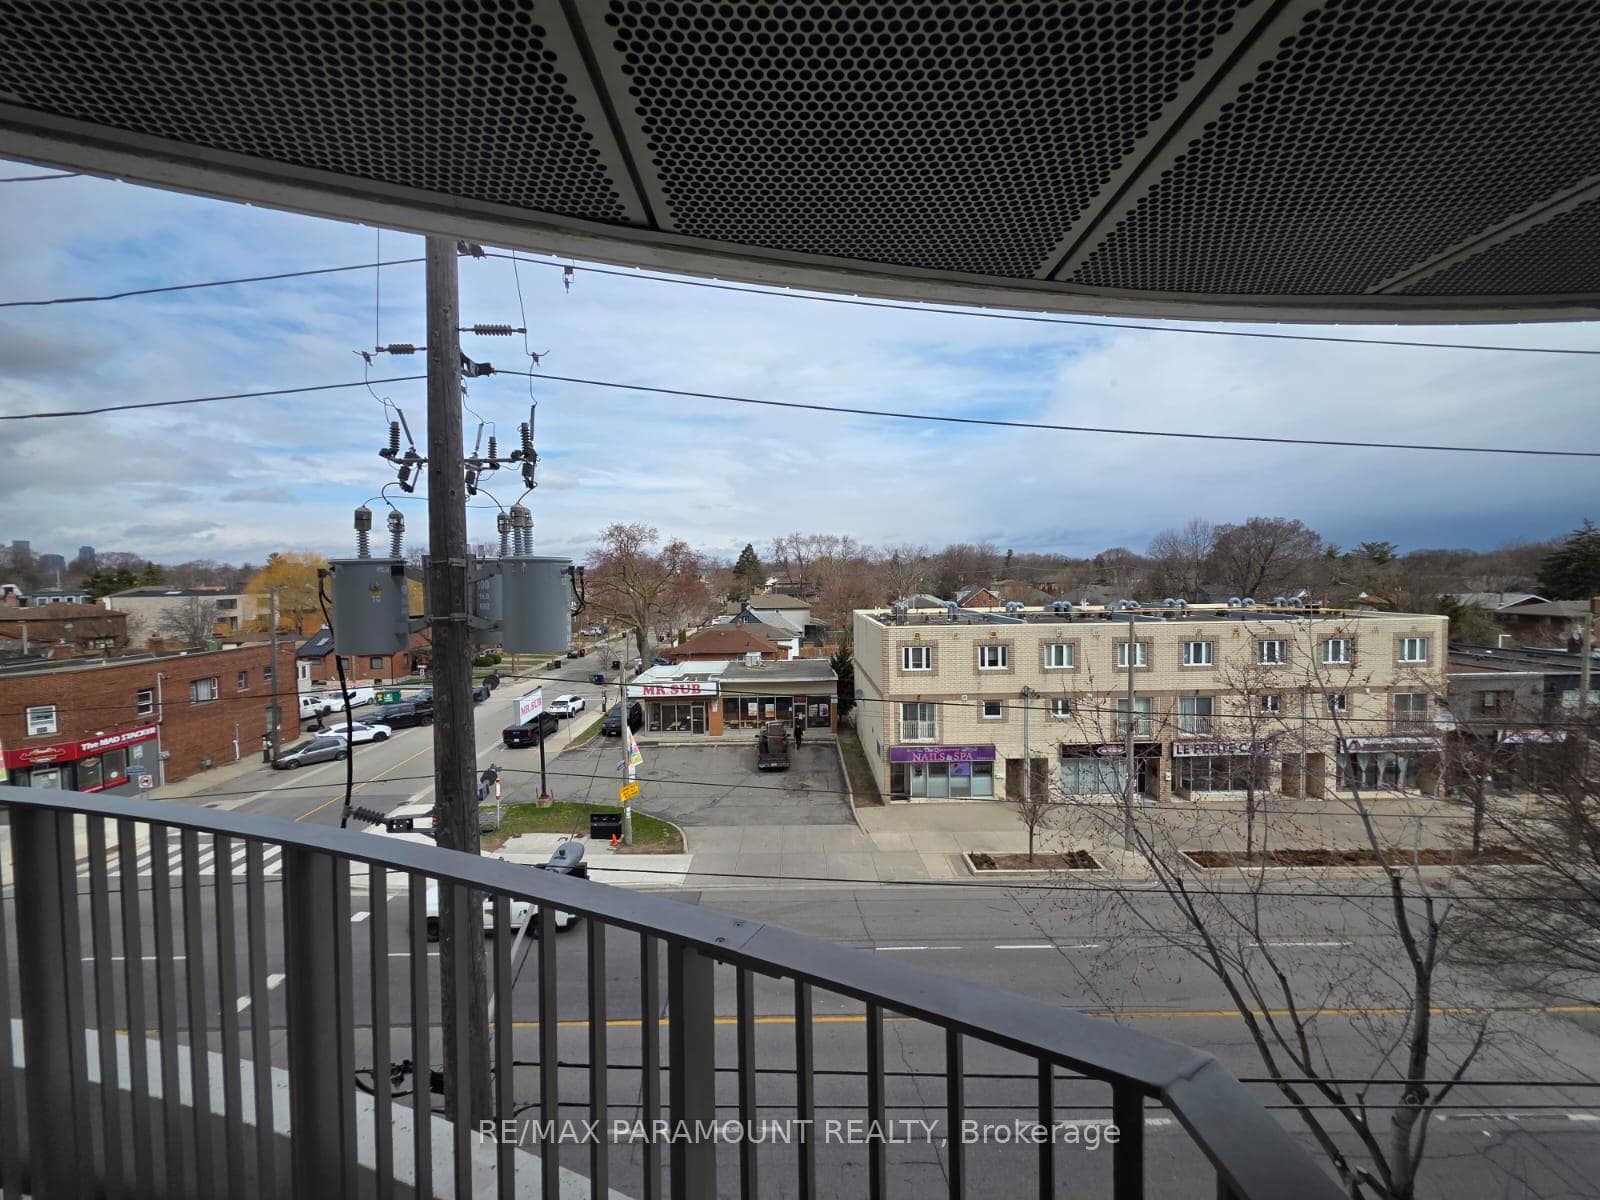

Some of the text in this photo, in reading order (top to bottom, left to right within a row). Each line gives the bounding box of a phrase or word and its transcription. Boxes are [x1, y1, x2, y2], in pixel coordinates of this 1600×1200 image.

[643, 683, 702, 695] MR SUB
[530, 697, 542, 711] SUB
[1176, 744, 1190, 755] LE
[912, 752, 945, 762] NAILS
[953, 752, 973, 761] SPA
